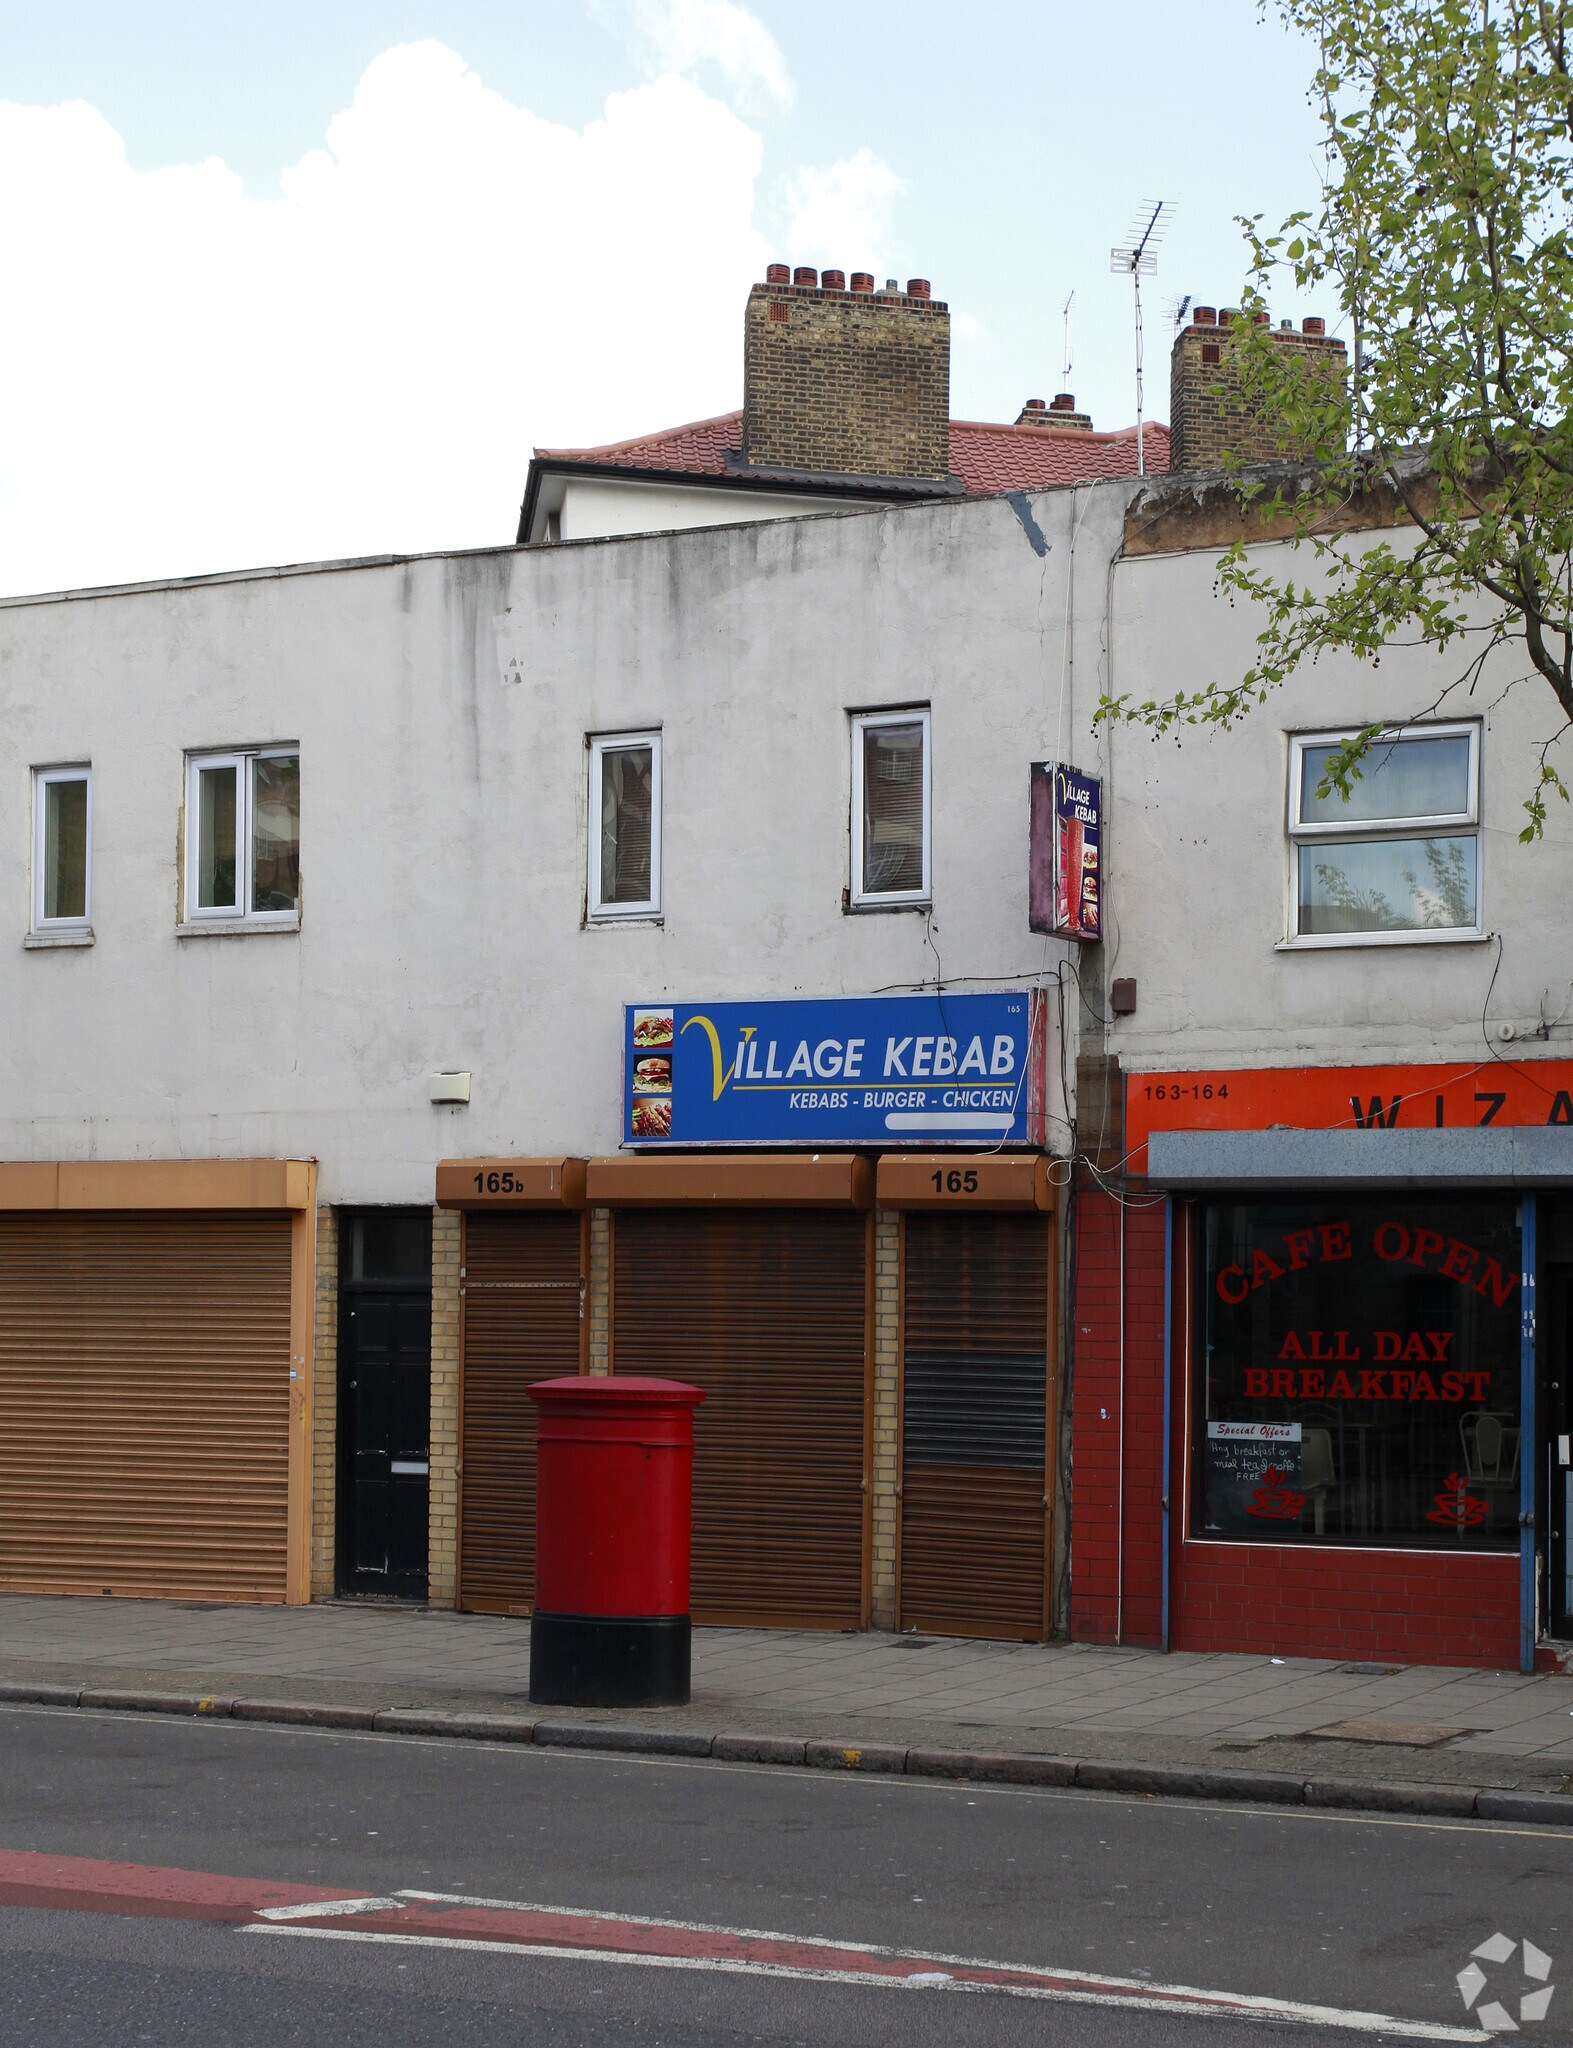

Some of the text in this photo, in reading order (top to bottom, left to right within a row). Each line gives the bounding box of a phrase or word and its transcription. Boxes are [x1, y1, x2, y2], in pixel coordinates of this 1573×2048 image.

[1057, 772, 1090, 805] VILLAGE
[1074, 804, 1097, 824] KEBAB
[1007, 1005, 1020, 1013] 165
[680, 1015, 1015, 1102] VILLAGE KEBAB
[789, 1092, 848, 1109] KEBABS
[863, 1091, 926, 1108] BURGER
[942, 1090, 1014, 1107] CHICKEN
[1144, 1083, 1229, 1101] 163-164
[473, 1172, 524, 1193] 165b
[931, 1170, 979, 1193] 165
[1216, 1222, 1521, 1308] CAFE OPEN
[1277, 1330, 1453, 1362] ALL DAY
[1243, 1367, 1491, 1401] BREAKFAST
[1217, 1424, 1290, 1438] Special Offers
[1211, 1443, 1289, 1458] Any breakfast or
[1214, 1458, 1238, 1469] meal
[1241, 1458, 1260, 1471] tea
[1236, 1472, 1260, 1482] FREE
